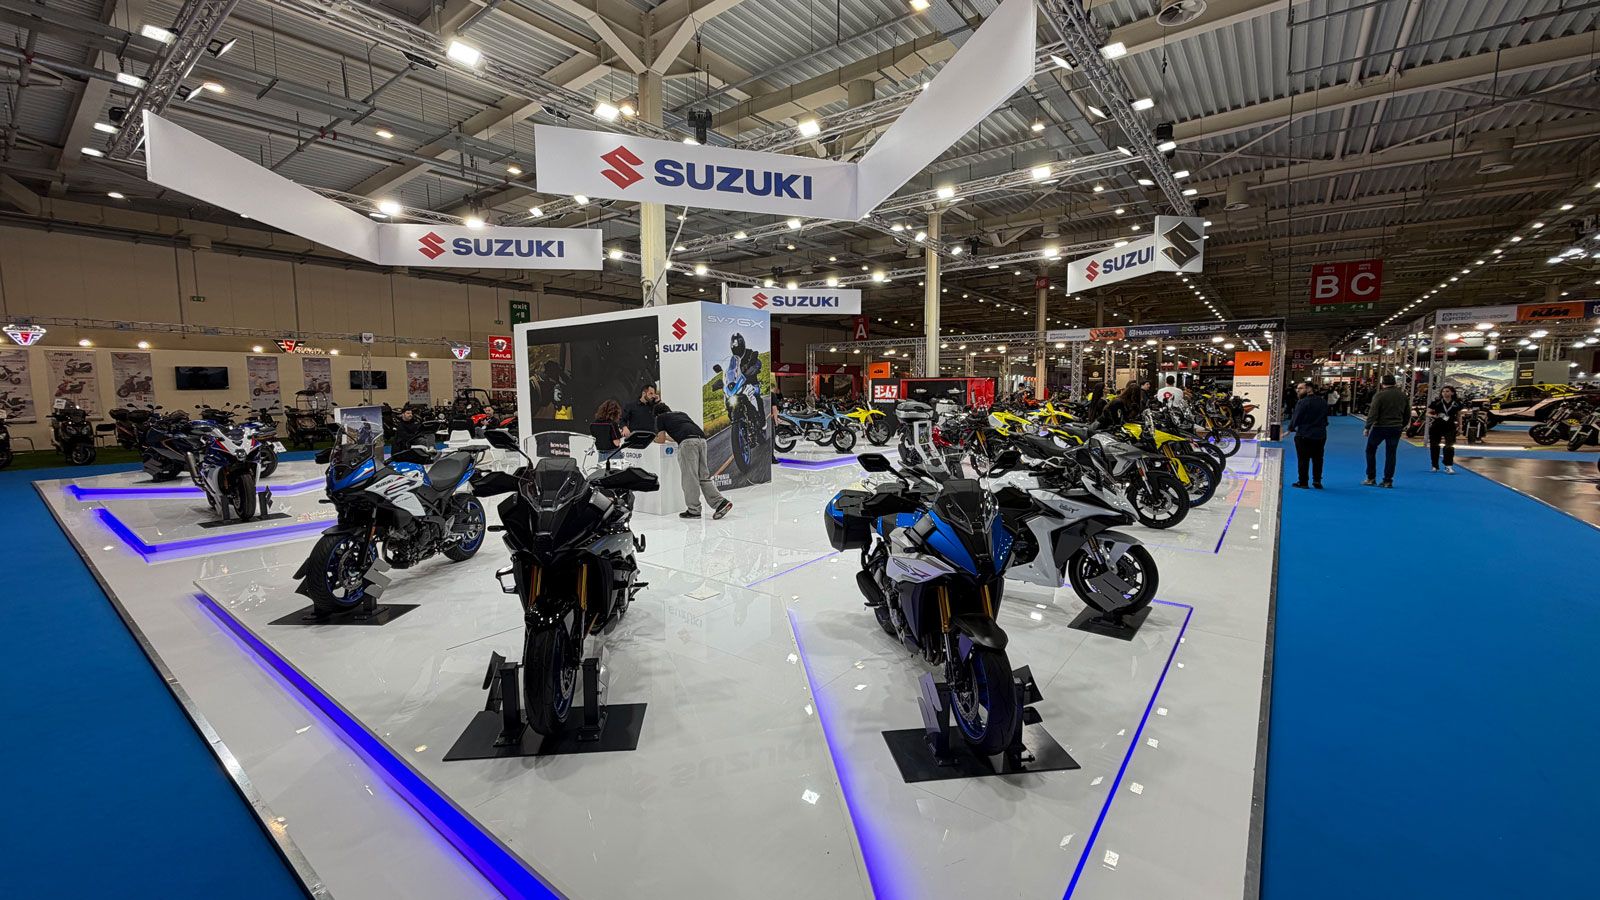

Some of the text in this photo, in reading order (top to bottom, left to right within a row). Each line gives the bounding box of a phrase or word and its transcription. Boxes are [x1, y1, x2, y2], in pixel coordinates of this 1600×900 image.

[654, 158, 813, 201] SUZUKI
[452, 237, 565, 258] SUZUKI
[1315, 272, 1376, 299] B C
[771, 295, 839, 307] SUZUKI
[1530, 307, 1570, 318] KTM
[855, 323, 868, 339] A
[1135, 328, 1170, 337] Husqvarna
[662, 343, 698, 353] SUZUKI
[874, 385, 898, 398] ヨシムラ
[626, 451, 642, 459] GROUP
